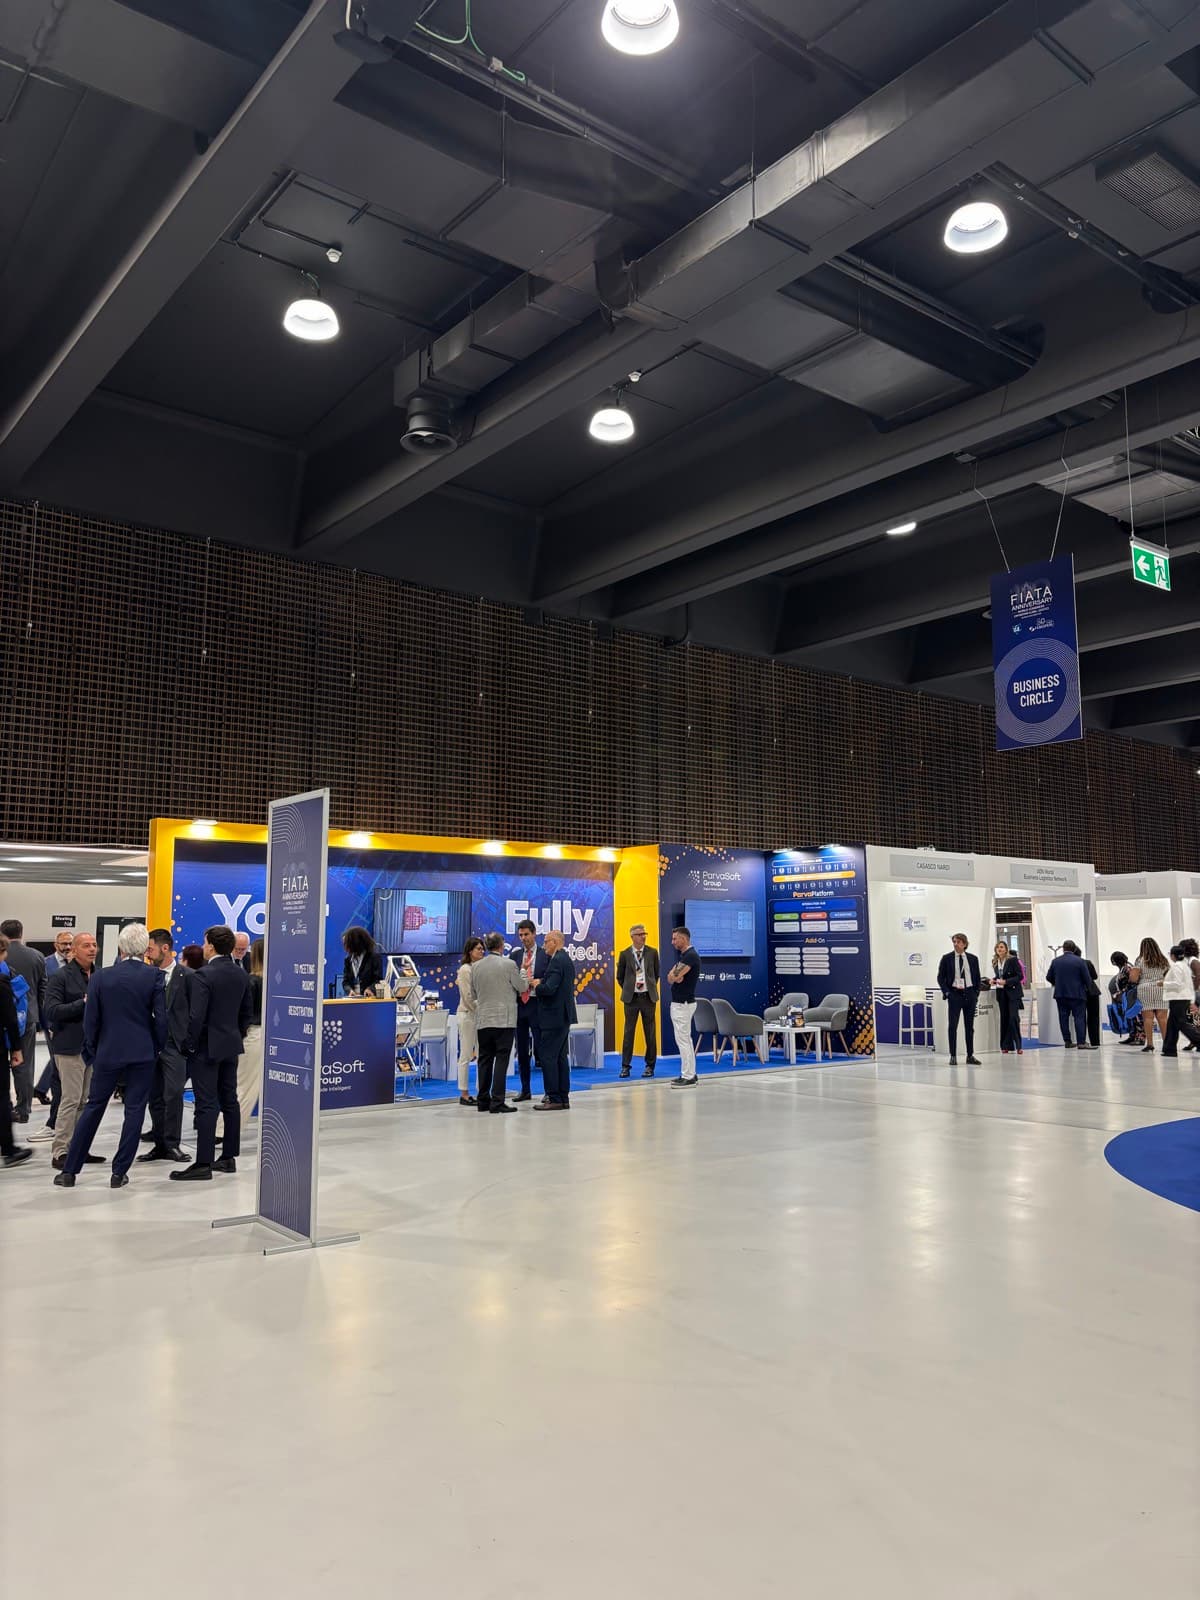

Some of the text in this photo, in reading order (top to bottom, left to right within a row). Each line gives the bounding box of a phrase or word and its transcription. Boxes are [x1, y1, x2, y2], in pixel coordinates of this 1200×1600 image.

[1010, 586, 1053, 606] FIATA
[1011, 597, 1053, 612] ANNIVERSARY
[1013, 674, 1060, 694] BUSINESS
[1020, 690, 1054, 708] CIRCLE
[282, 875, 309, 892] FIATA
[702, 871, 742, 881] ParvaSoft
[793, 889, 834, 898] ParvaPlatform
[506, 900, 594, 942] Fully
[299, 964, 315, 974] MEETING
